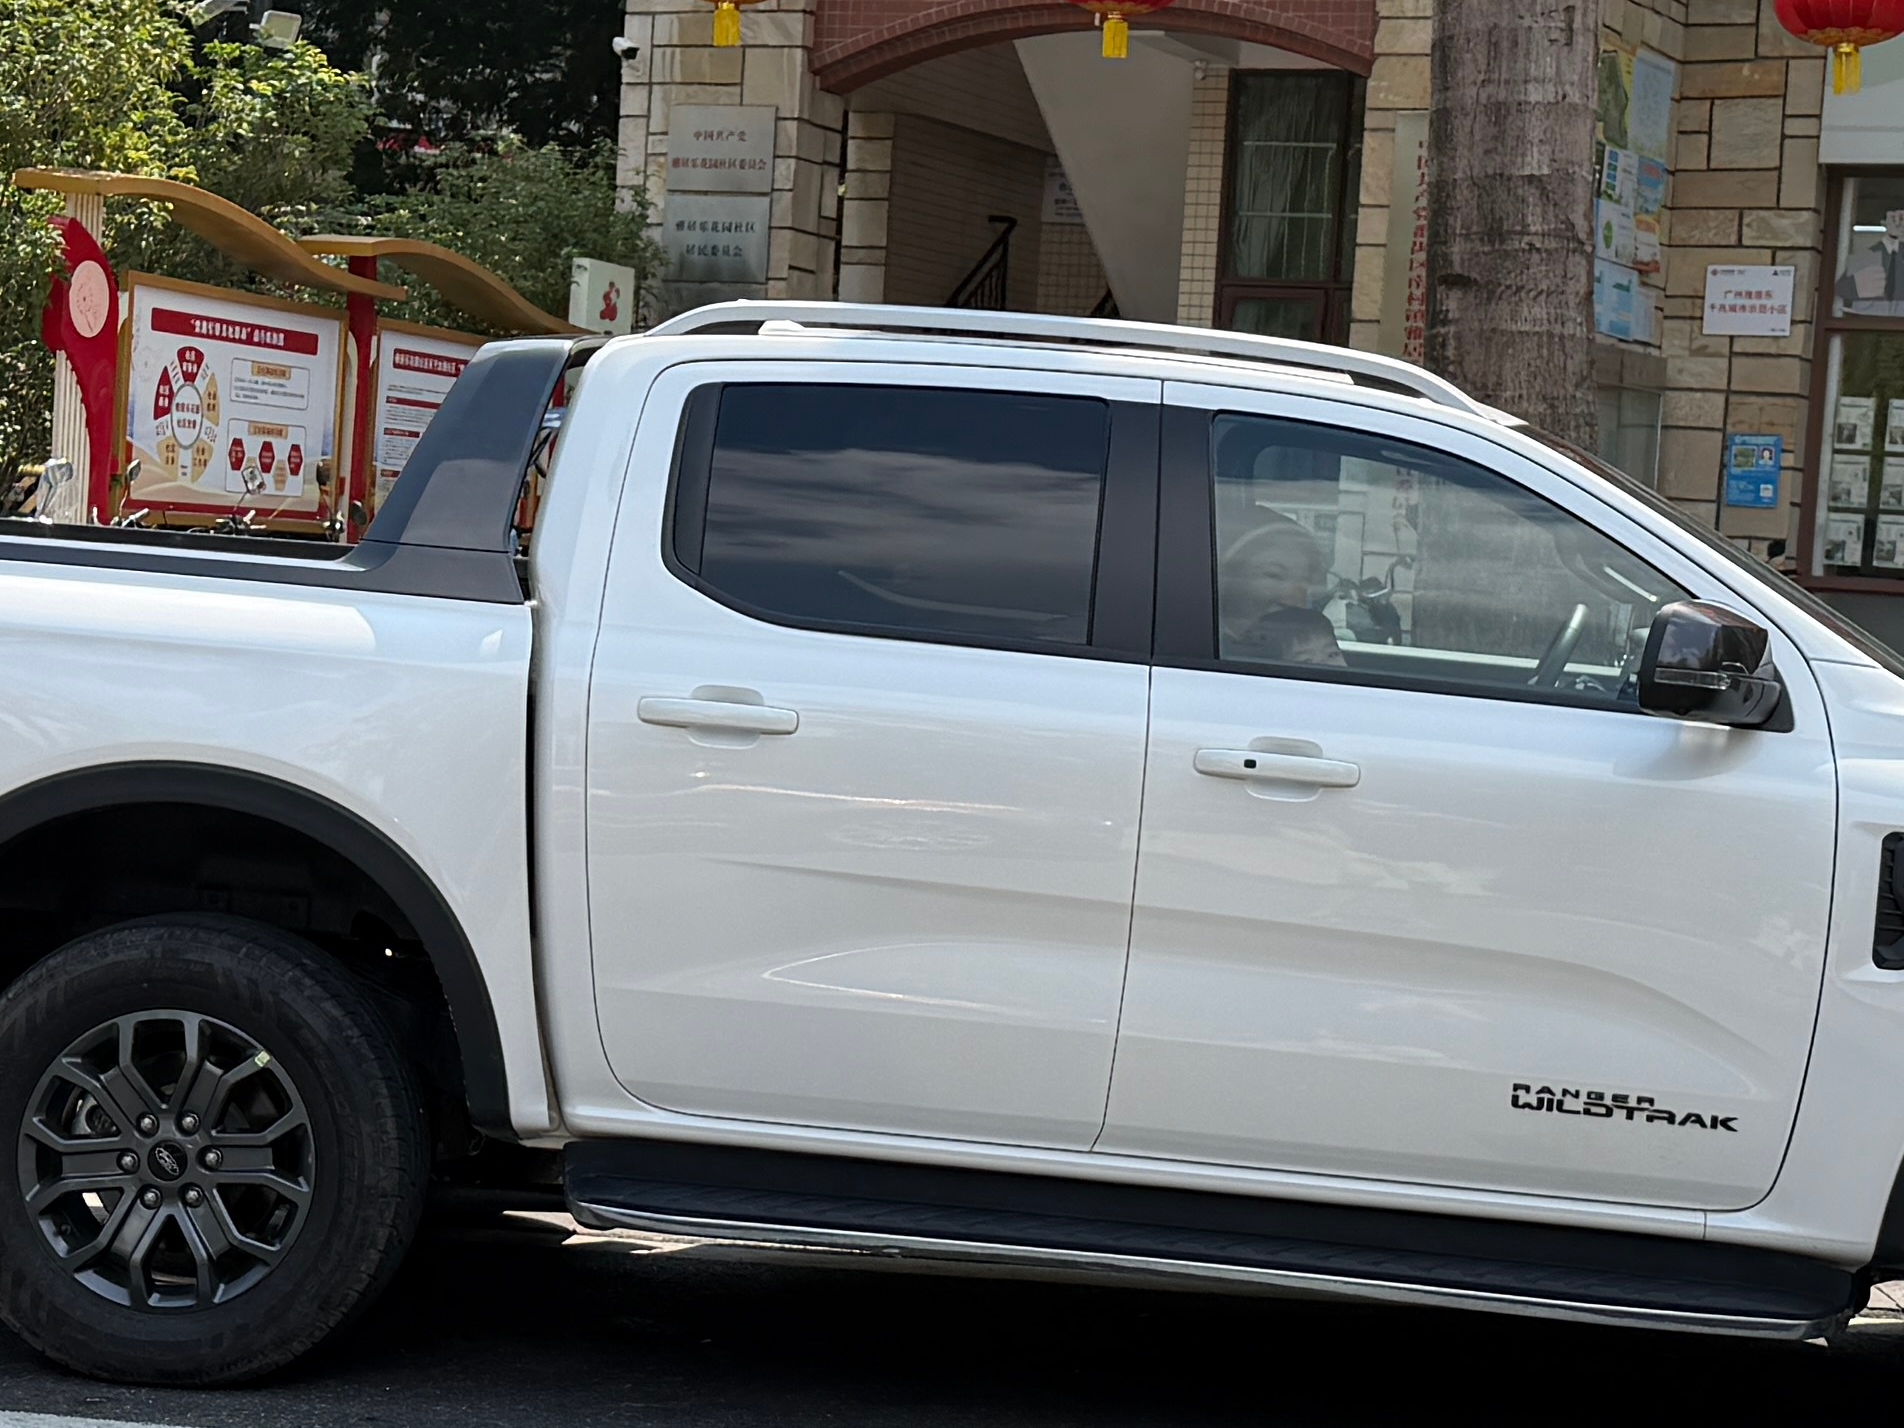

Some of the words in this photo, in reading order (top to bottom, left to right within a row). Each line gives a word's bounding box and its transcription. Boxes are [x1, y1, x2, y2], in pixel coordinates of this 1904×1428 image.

[693, 129, 748, 143] 中国共产党
[671, 156, 768, 171] 雅居乐花园社区委员会
[674, 219, 757, 234] 雅居乐花园社区
[685, 243, 744, 258] 居民委员会
[1512, 1082, 1655, 1107] RANGER
[1510, 1093, 1739, 1133] WILDTRAK
